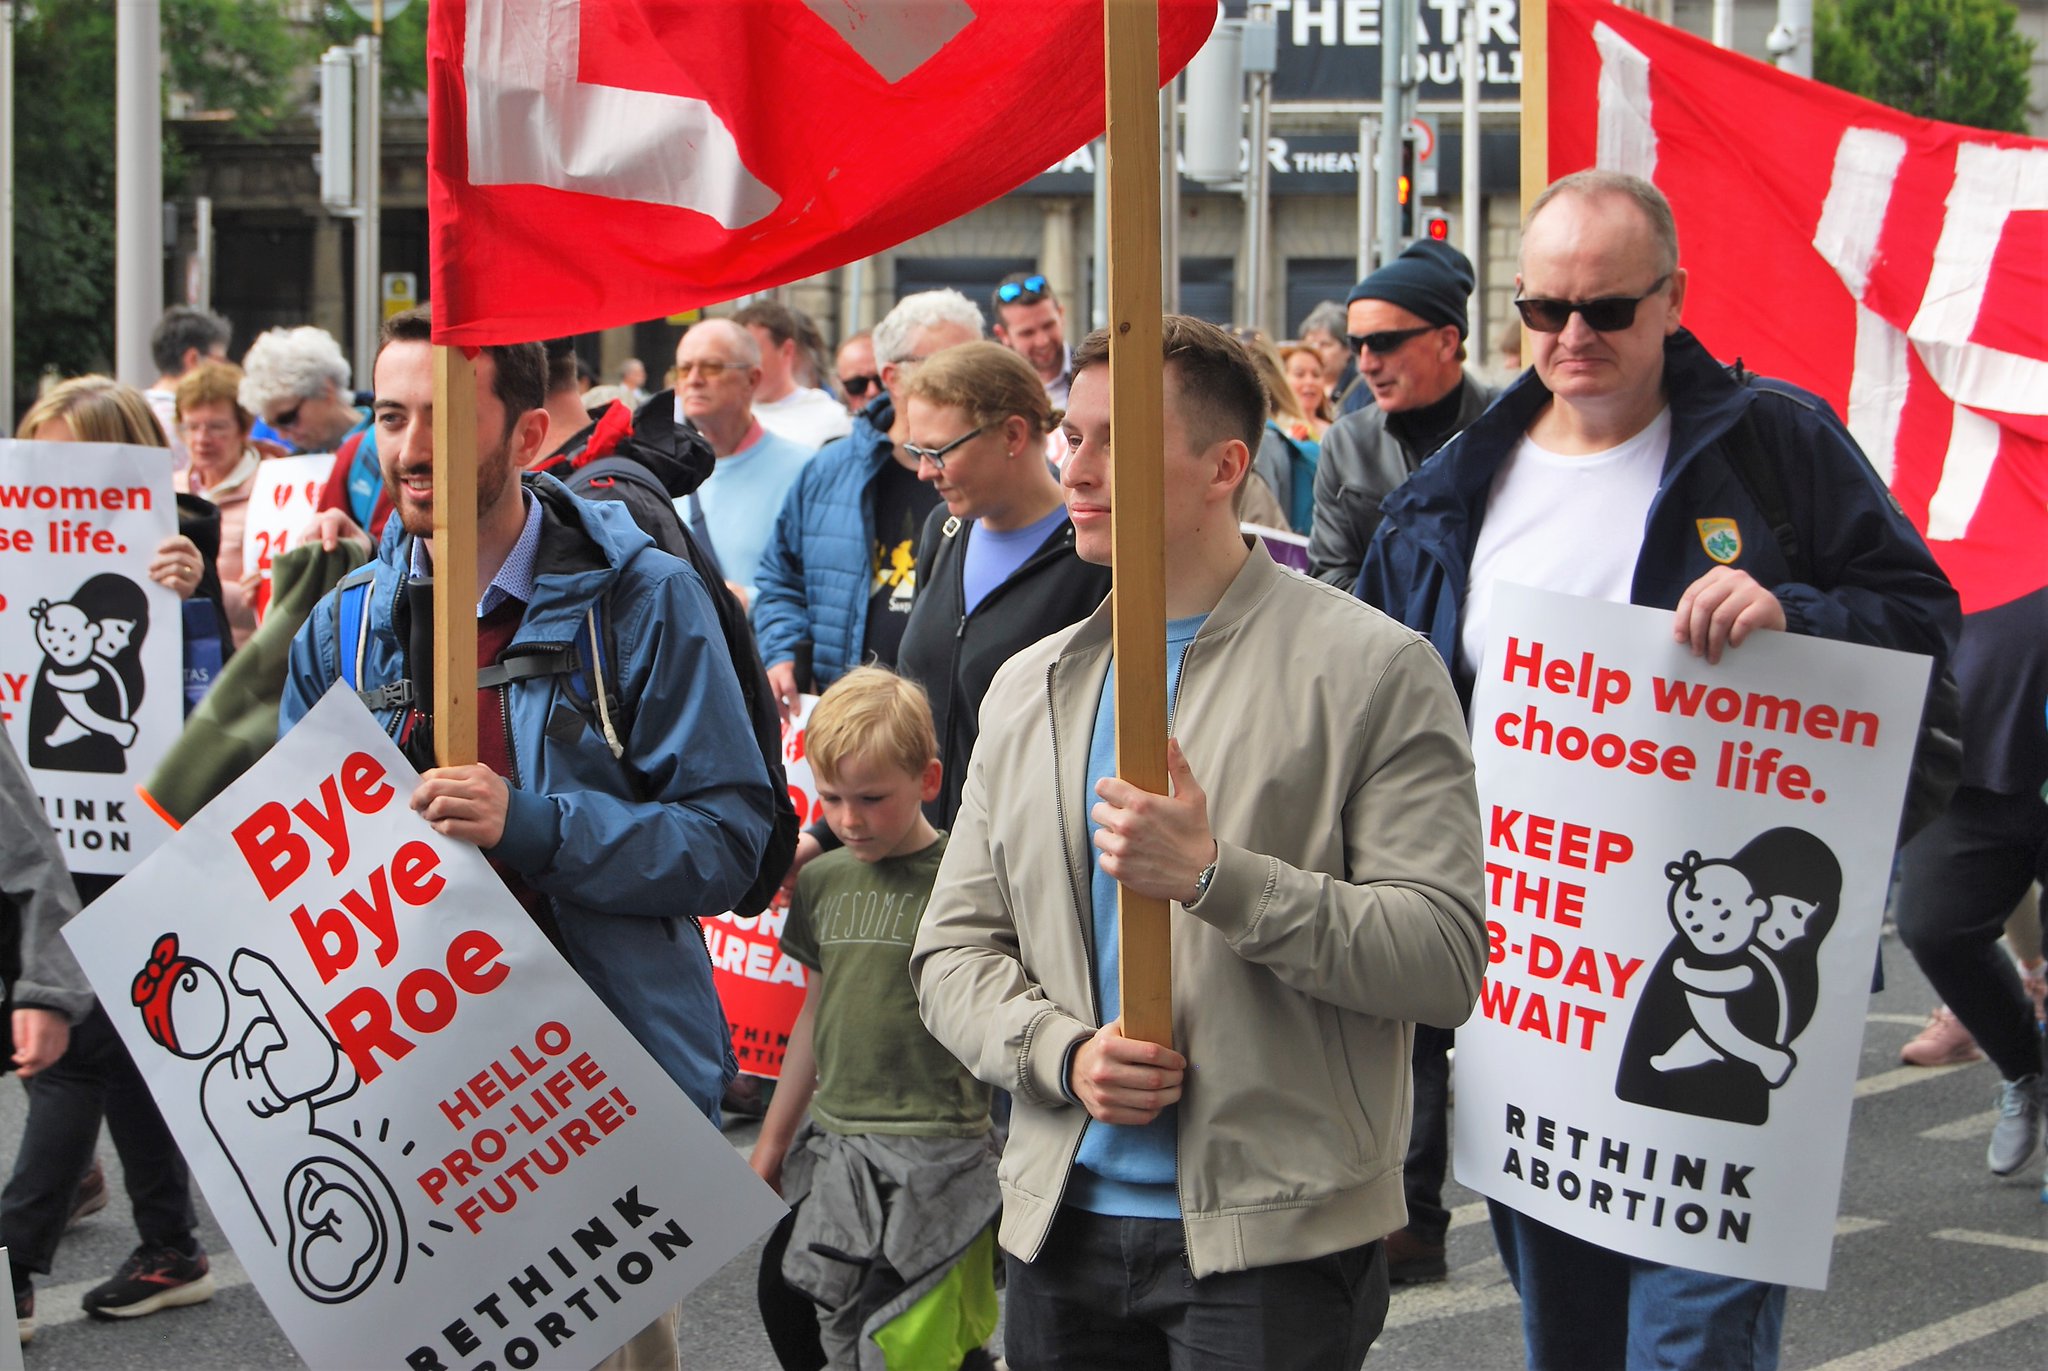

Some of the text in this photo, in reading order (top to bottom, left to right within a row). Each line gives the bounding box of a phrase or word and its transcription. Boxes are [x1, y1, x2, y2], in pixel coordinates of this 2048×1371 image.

[49, 519, 128, 555] life.
[1503, 636, 1879, 748] Help women
[1494, 705, 1827, 805] choose life.
[54, 829, 131, 852] ION
[231, 751, 396, 902] Bye
[1489, 805, 1634, 875] KEEP
[290, 840, 447, 985] bye
[1484, 861, 1587, 929] THE
[325, 930, 511, 1085] Roe
[1485, 920, 1645, 1000] 3-DAY
[1480, 976, 1607, 1052] WAIT
[438, 1021, 572, 1131] HELLO
[416, 1052, 608, 1206] PRO-LIFE
[455, 1086, 638, 1234] FUTURE!
[1505, 1102, 1757, 1201] RETHINK
[1502, 1147, 1753, 1245] ABORTION
[471, 1218, 694, 1371] ORTION
